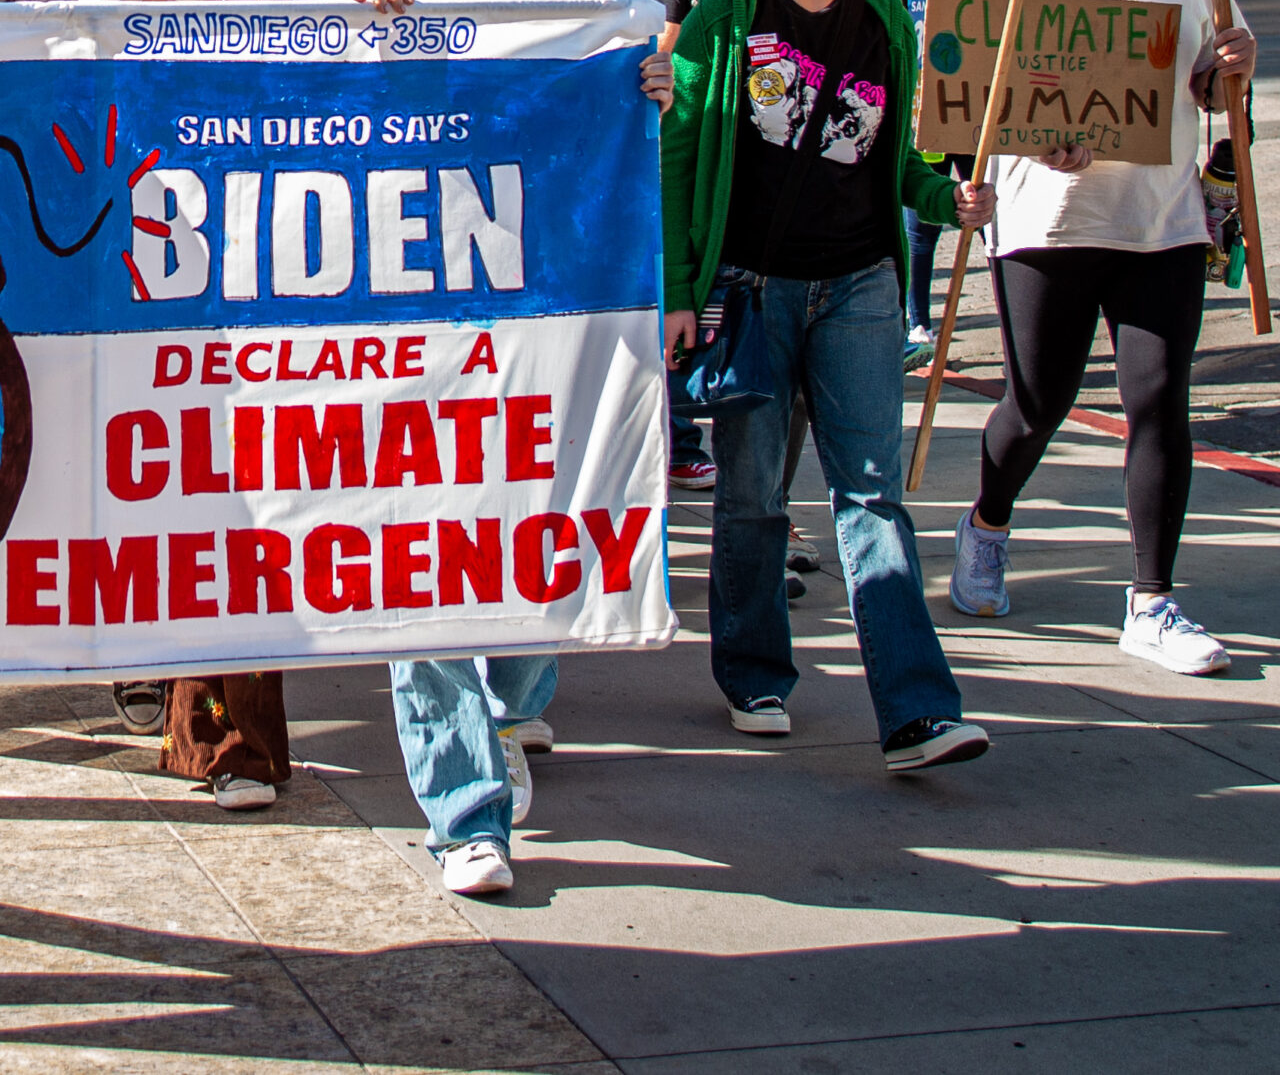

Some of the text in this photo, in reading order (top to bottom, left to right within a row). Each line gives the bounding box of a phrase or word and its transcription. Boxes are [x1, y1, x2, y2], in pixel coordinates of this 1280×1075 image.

[123, 13, 477, 55] SANDIEGO 350
[1017, 53, 1087, 72] USTICE
[937, 78, 1158, 127] HUMAN
[177, 112, 470, 147] SAN DIEGO SAYS
[130, 163, 525, 303] BIDEN
[153, 332, 499, 388] DECLARE A
[106, 394, 555, 502] CLIMATE
[5, 507, 653, 627] EMERGENCY
